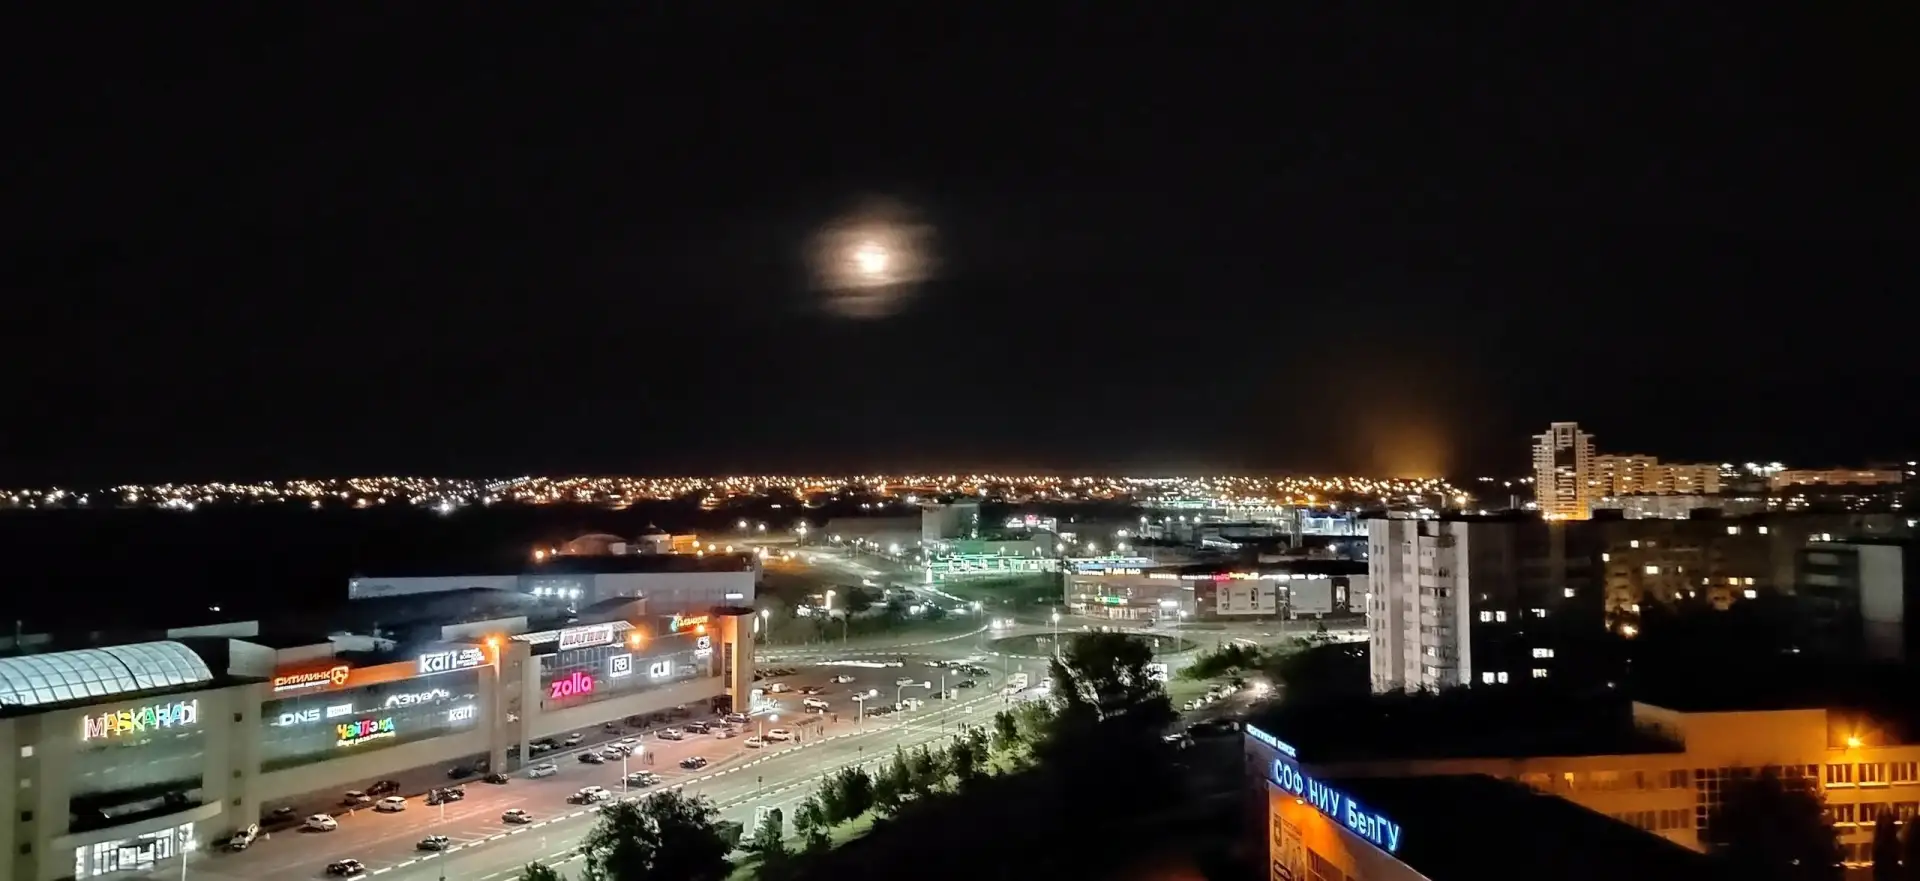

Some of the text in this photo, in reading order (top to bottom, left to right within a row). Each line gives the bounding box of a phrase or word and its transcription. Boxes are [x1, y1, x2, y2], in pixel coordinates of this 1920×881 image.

[420, 650, 457, 673] kari
[274, 671, 331, 686] СИТИЛИНК
[552, 672, 592, 698] zolla
[279, 708, 320, 726] DNS
[1274, 758, 1303, 795] СОФ
[1308, 777, 1340, 817] НИУ
[1347, 798, 1400, 851] БелГУ
